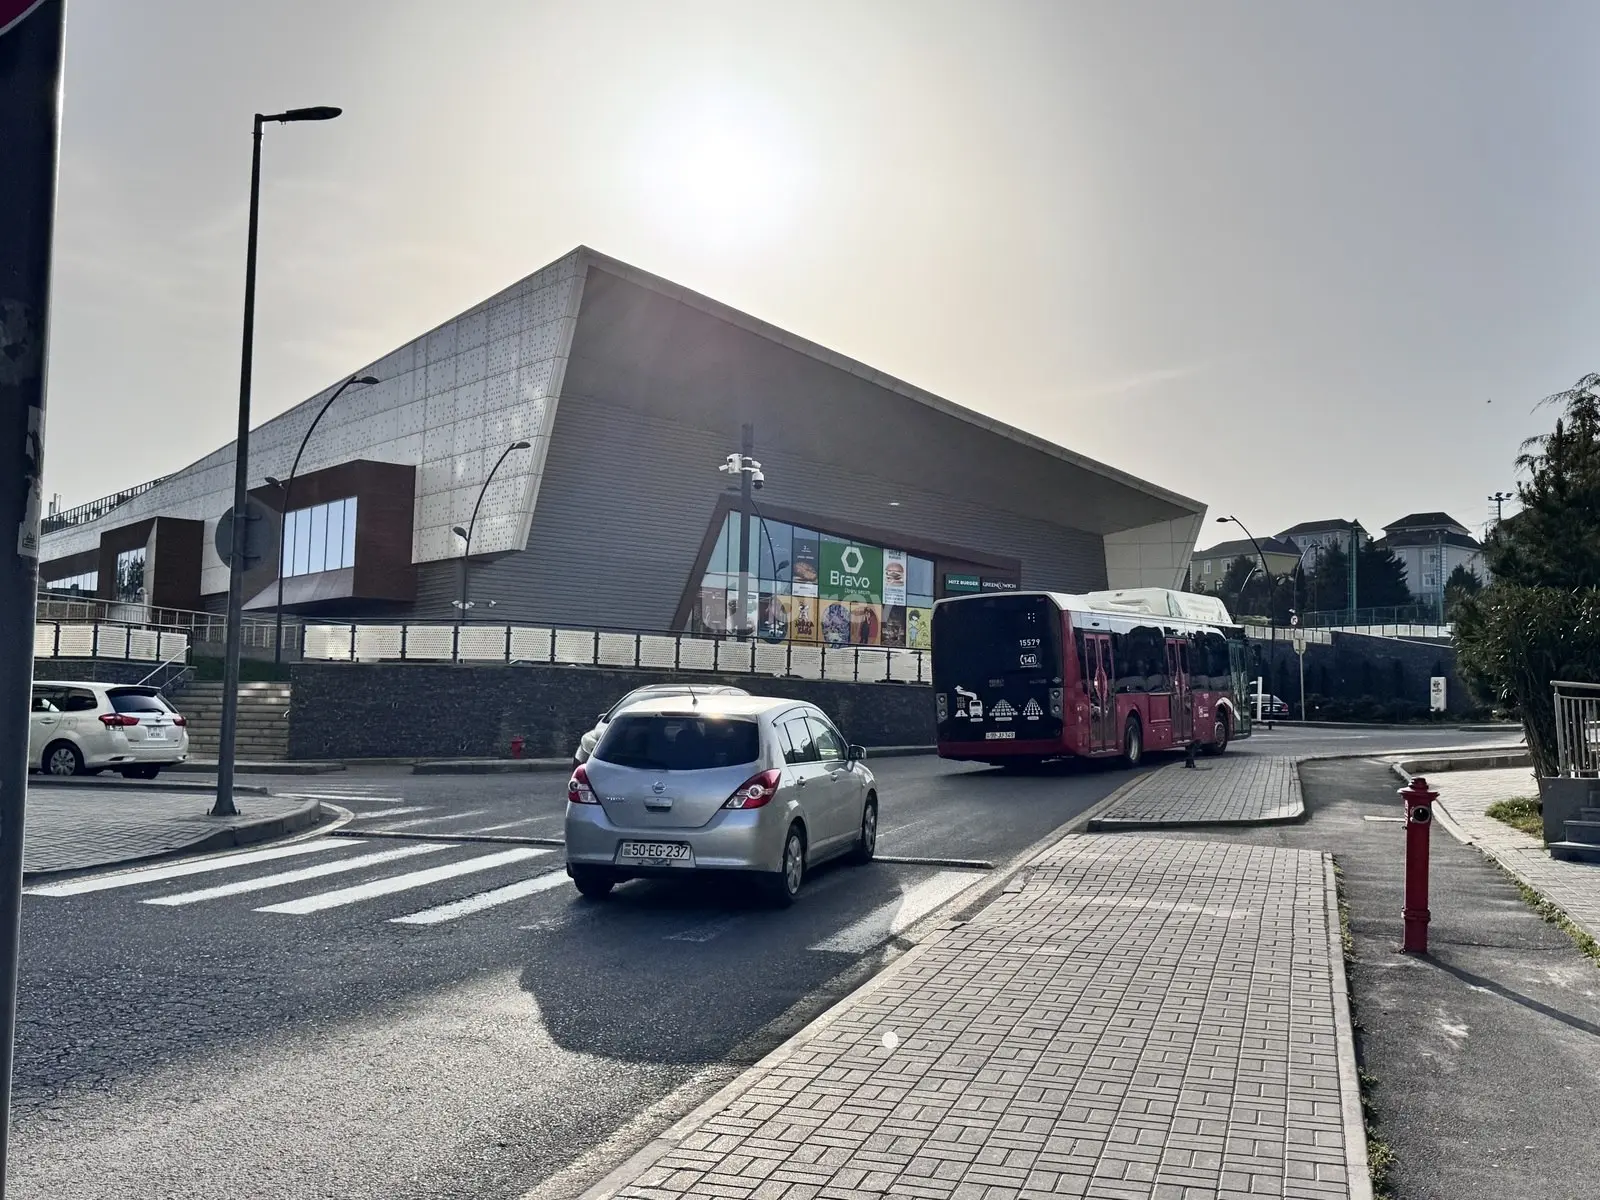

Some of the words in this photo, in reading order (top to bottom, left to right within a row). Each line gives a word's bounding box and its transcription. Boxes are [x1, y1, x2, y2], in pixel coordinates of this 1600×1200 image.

[830, 570, 870, 588] Bravo
[1019, 638, 1041, 647] 15579
[631, 843, 688, 858] 50-EG-237
